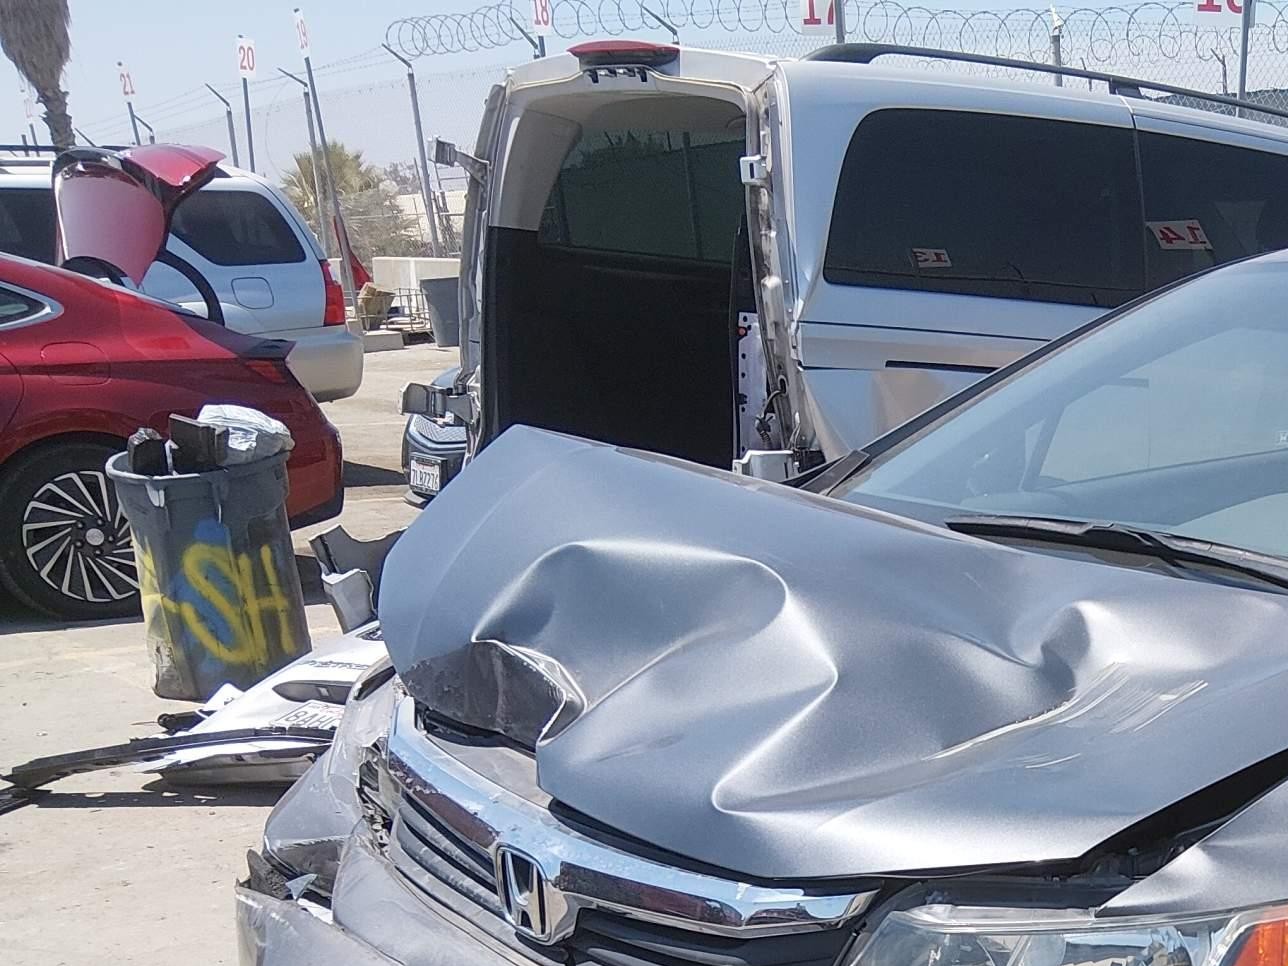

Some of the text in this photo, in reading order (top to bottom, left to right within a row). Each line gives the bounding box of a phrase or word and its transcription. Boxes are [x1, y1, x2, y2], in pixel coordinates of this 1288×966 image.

[296, 19, 308, 49] 19
[238, 45, 255, 71] 20
[119, 72, 135, 96] 21
